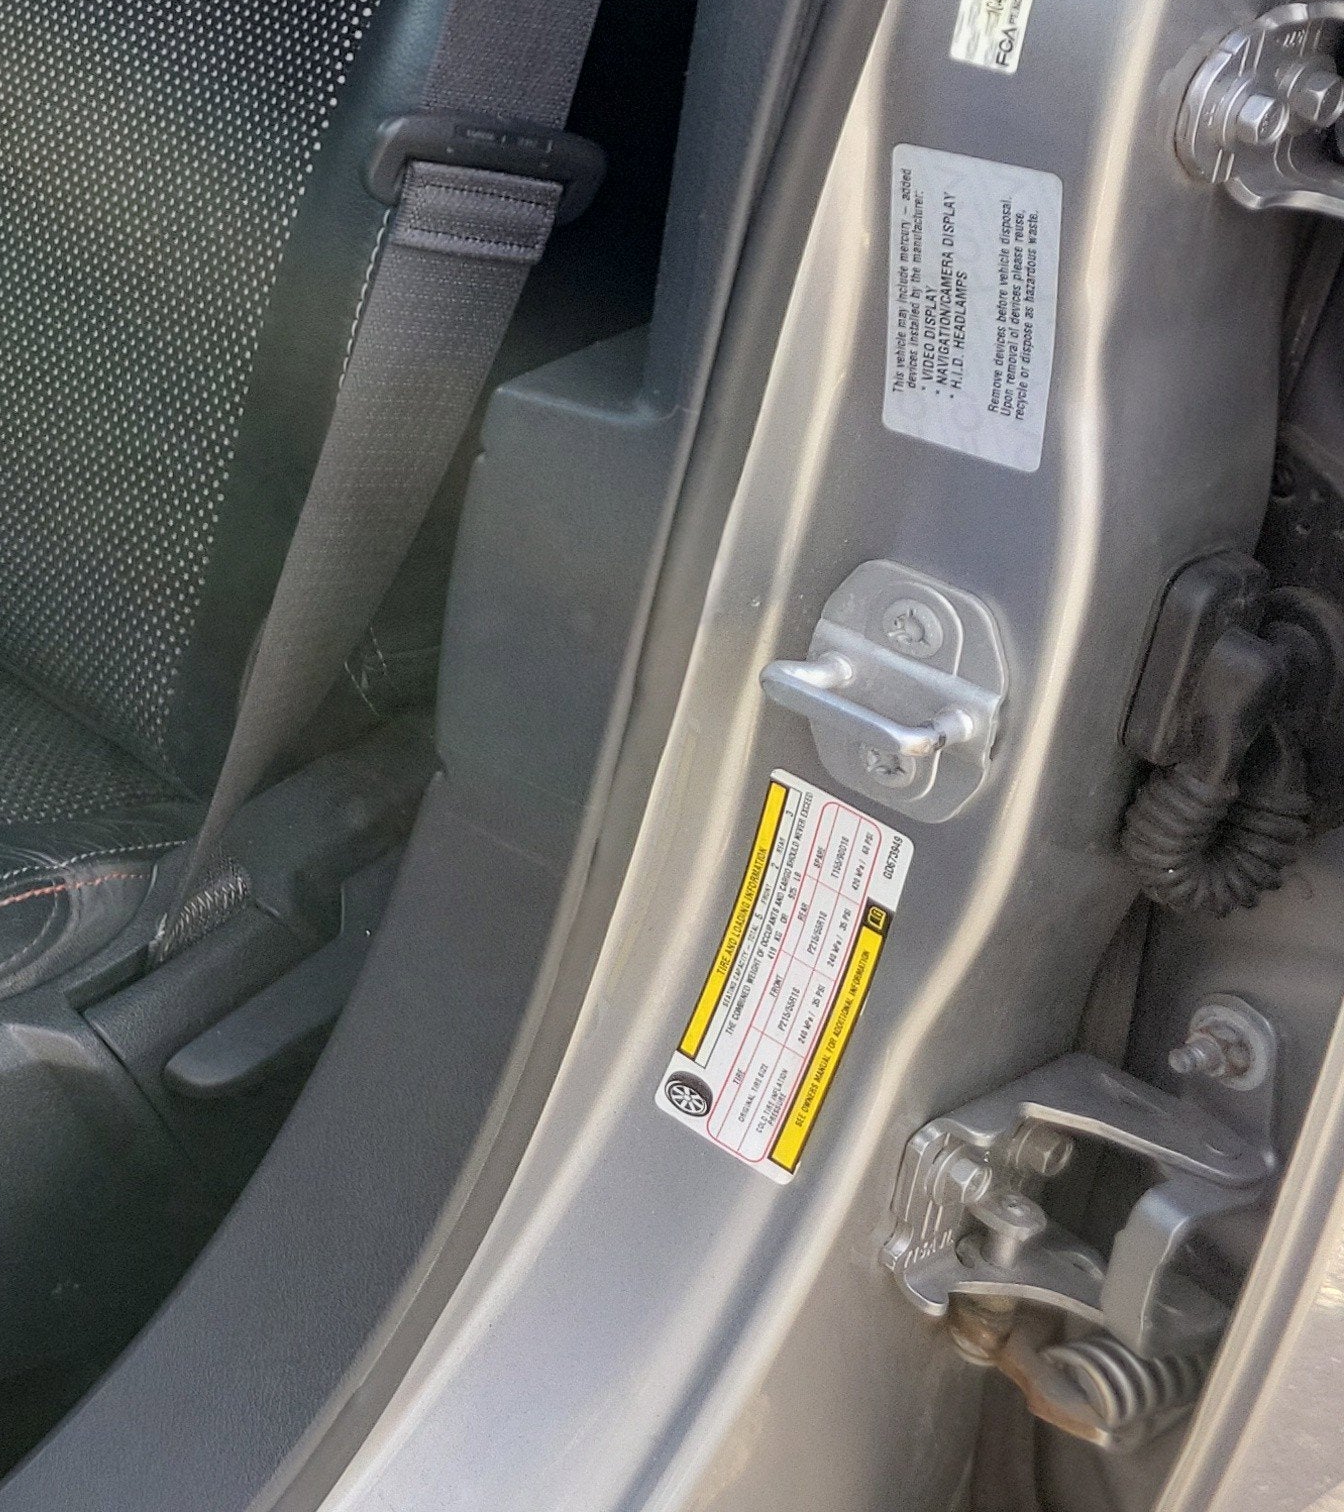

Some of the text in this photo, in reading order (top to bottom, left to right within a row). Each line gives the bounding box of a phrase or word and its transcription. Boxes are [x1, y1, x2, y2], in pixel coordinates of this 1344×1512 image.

[996, 28, 1017, 66] FCA
[901, 168, 912, 201] added
[899, 220, 910, 262] mercury
[896, 266, 909, 303] include
[910, 287, 921, 299] by
[911, 267, 921, 283] the
[936, 191, 956, 385] NAVIGATION/CAMERA DISPLAY
[1024, 248, 1036, 303] hazardous
[897, 308, 909, 328] may
[987, 197, 1012, 413] Remove devices before vehicle disposal.
[1000, 210, 1026, 416] Upon removal of devices please reuse,
[1024, 307, 1034, 319] as
[908, 302, 921, 347] installed
[922, 285, 937, 380] VIDEO DISPLAY
[951, 270, 968, 389] H.I.D. HEADLAMPS
[1020, 322, 1034, 364] dispose
[894, 331, 906, 368] vehicle
[893, 371, 904, 392] This
[907, 350, 917, 389] devices
[1020, 366, 1029, 378] or
[1015, 381, 1028, 420] recycle
[814, 846, 824, 868] SPARE
[883, 836, 902, 879] GD673949
[716, 846, 767, 974] TIRE AND LOADING INFORMATION
[725, 792, 813, 1035] THE COMBINED WEIGHT OF OCCUPANTS AND CARGO SHOULD NEVER EXCEED
[774, 930, 782, 942] KG
[780, 913, 788, 923] OR
[798, 903, 809, 922] REAR
[842, 908, 851, 921] PSI
[768, 974, 783, 998] FRONT
[816, 984, 826, 997] PSI
[795, 950, 870, 1127] SEE OWNERS MANUAL FOR ADDITIONAL INFORMATION
[732, 1068, 746, 1085] TIRE
[738, 1063, 768, 1122] ORIGINAL TIRE SIZE
[756, 1068, 788, 1133] COLD TIRE INFLATION
[768, 1092, 786, 1126] PRESSURE
